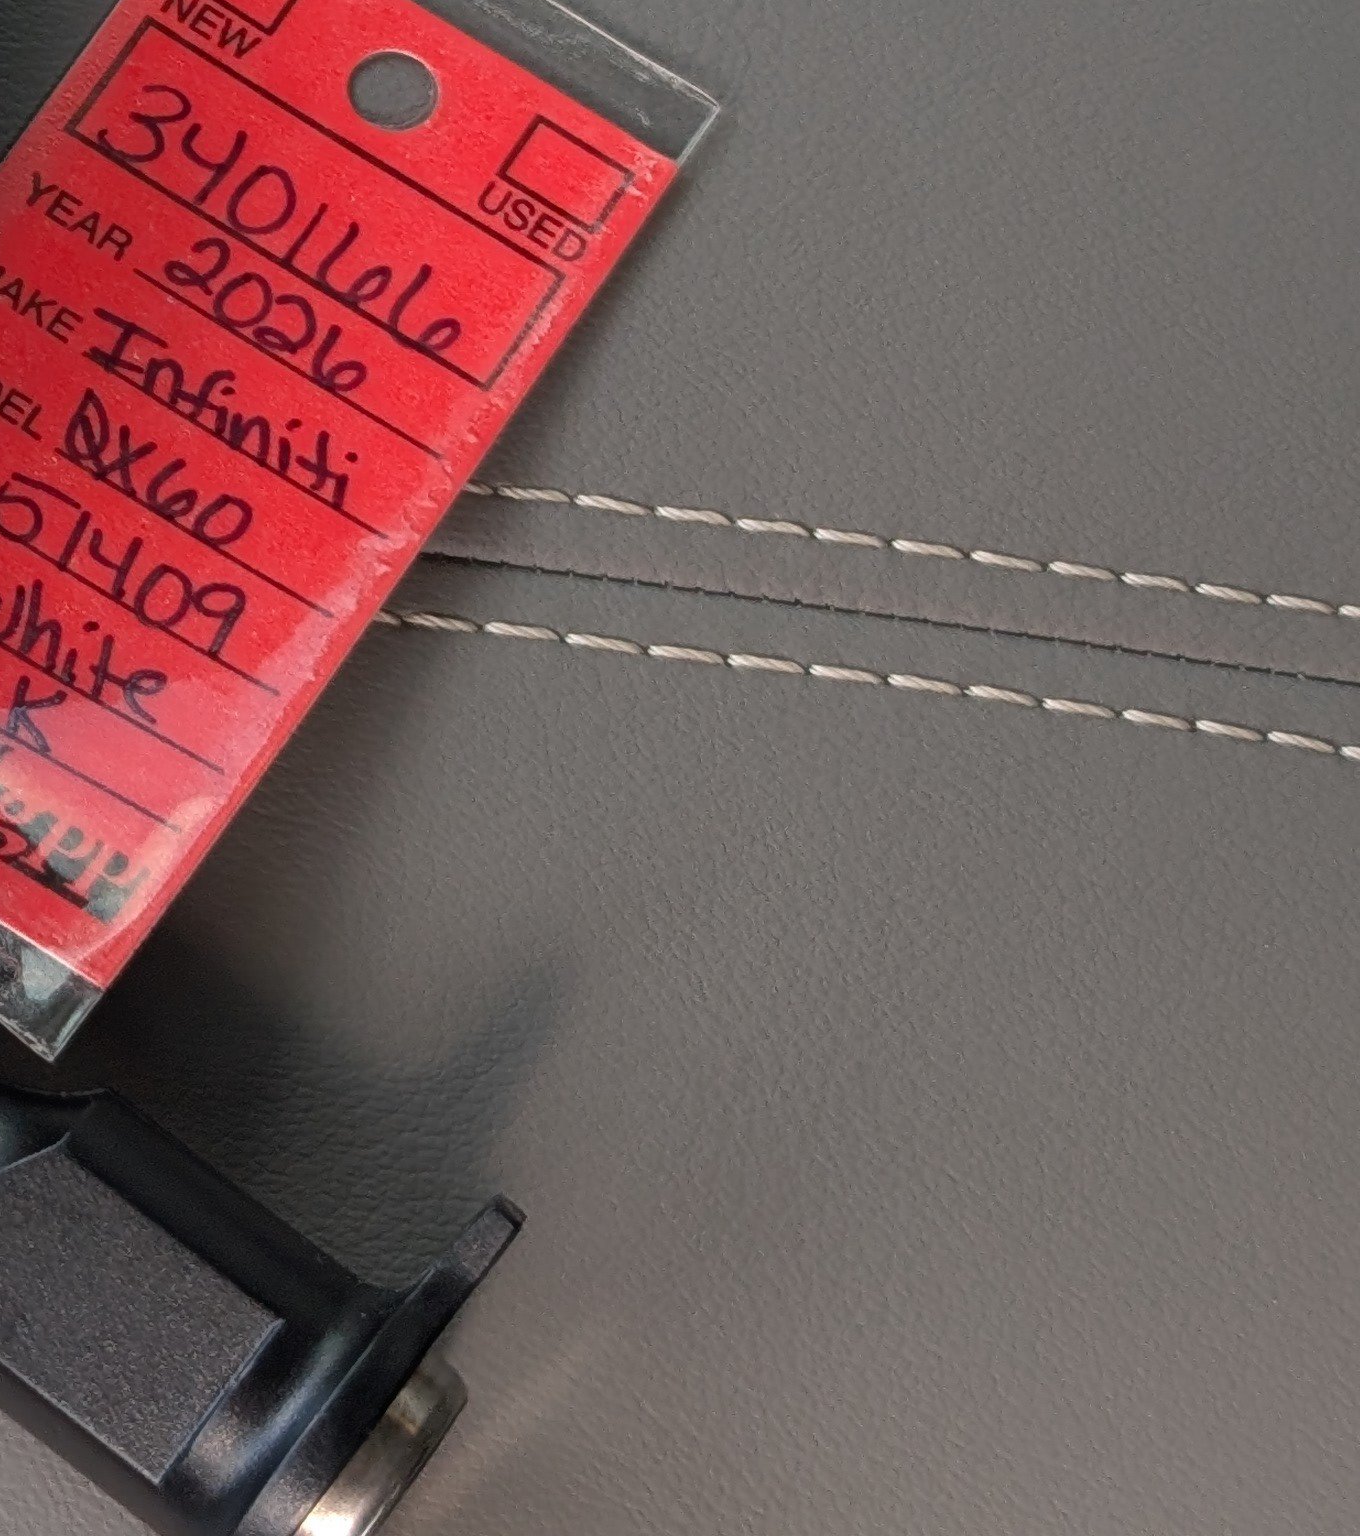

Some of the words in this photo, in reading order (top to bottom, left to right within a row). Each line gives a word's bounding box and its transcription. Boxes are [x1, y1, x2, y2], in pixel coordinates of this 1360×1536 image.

[28, 171, 134, 259] YEAR
[97, 84, 462, 354] 340166
[476, 180, 588, 262] USED
[163, 236, 367, 393] 2026
[83, 307, 358, 510] Infiniti
